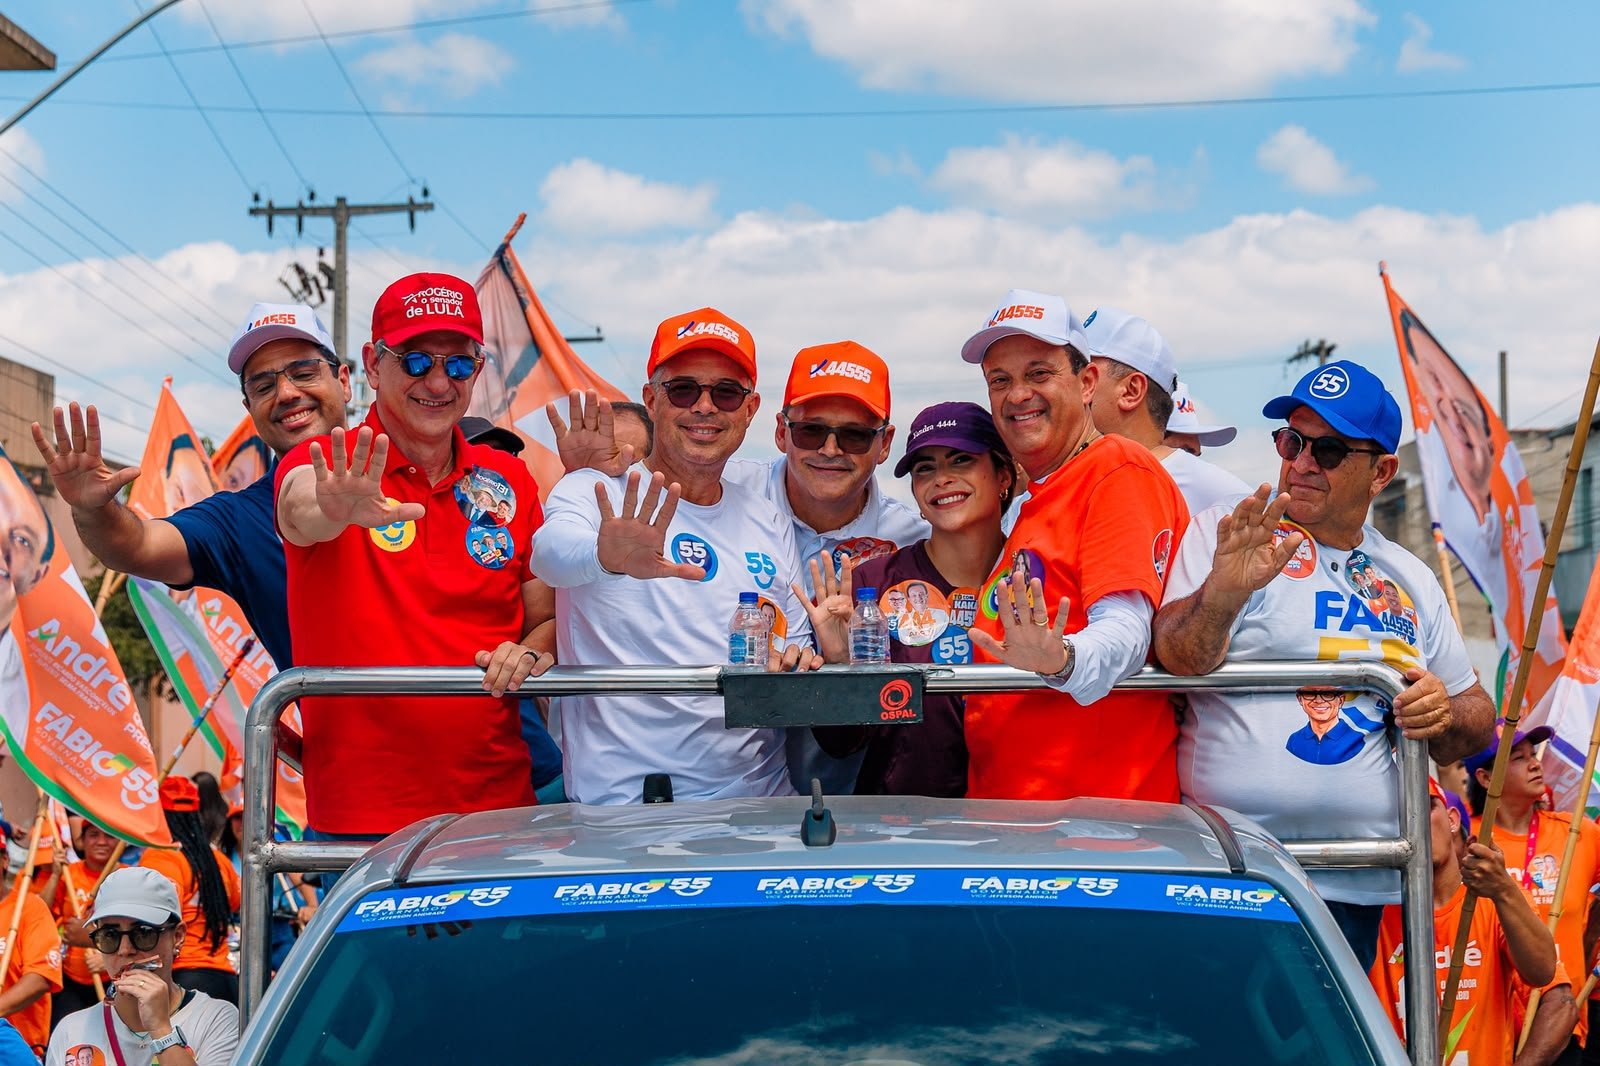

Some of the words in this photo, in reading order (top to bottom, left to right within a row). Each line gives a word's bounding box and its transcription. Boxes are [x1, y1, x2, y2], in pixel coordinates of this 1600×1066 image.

[418, 286, 463, 301] ROGÉRIO
[430, 297, 463, 306] senador
[406, 305, 424, 319] de
[426, 302, 465, 319] LULA
[1313, 373, 1345, 393] 55
[936, 420, 957, 428] 4444
[679, 541, 706, 559] 55
[744, 552, 777, 576] 55
[1382, 611, 1416, 637] 44555
[939, 634, 971, 659] 55
[880, 709, 917, 720] OSPAL
[34, 725, 99, 781] GOVERNADOR
[35, 702, 130, 777] FÁBIO
[122, 767, 159, 804] 55
[554, 880, 667, 898] FÁBIO
[668, 877, 713, 890] 55
[757, 875, 870, 891] FÁBIO
[872, 874, 916, 886] 55
[961, 876, 1074, 891] FÁBIO
[1076, 877, 1119, 890] 55
[355, 889, 466, 915] FÁBIO
[467, 886, 512, 901] 55
[561, 894, 649, 902] GOVERNADOR
[1166, 884, 1276, 904] FÁBIO
[1175, 896, 1262, 907] GOVERNADOR
[362, 906, 447, 918] GOVERNADOR
